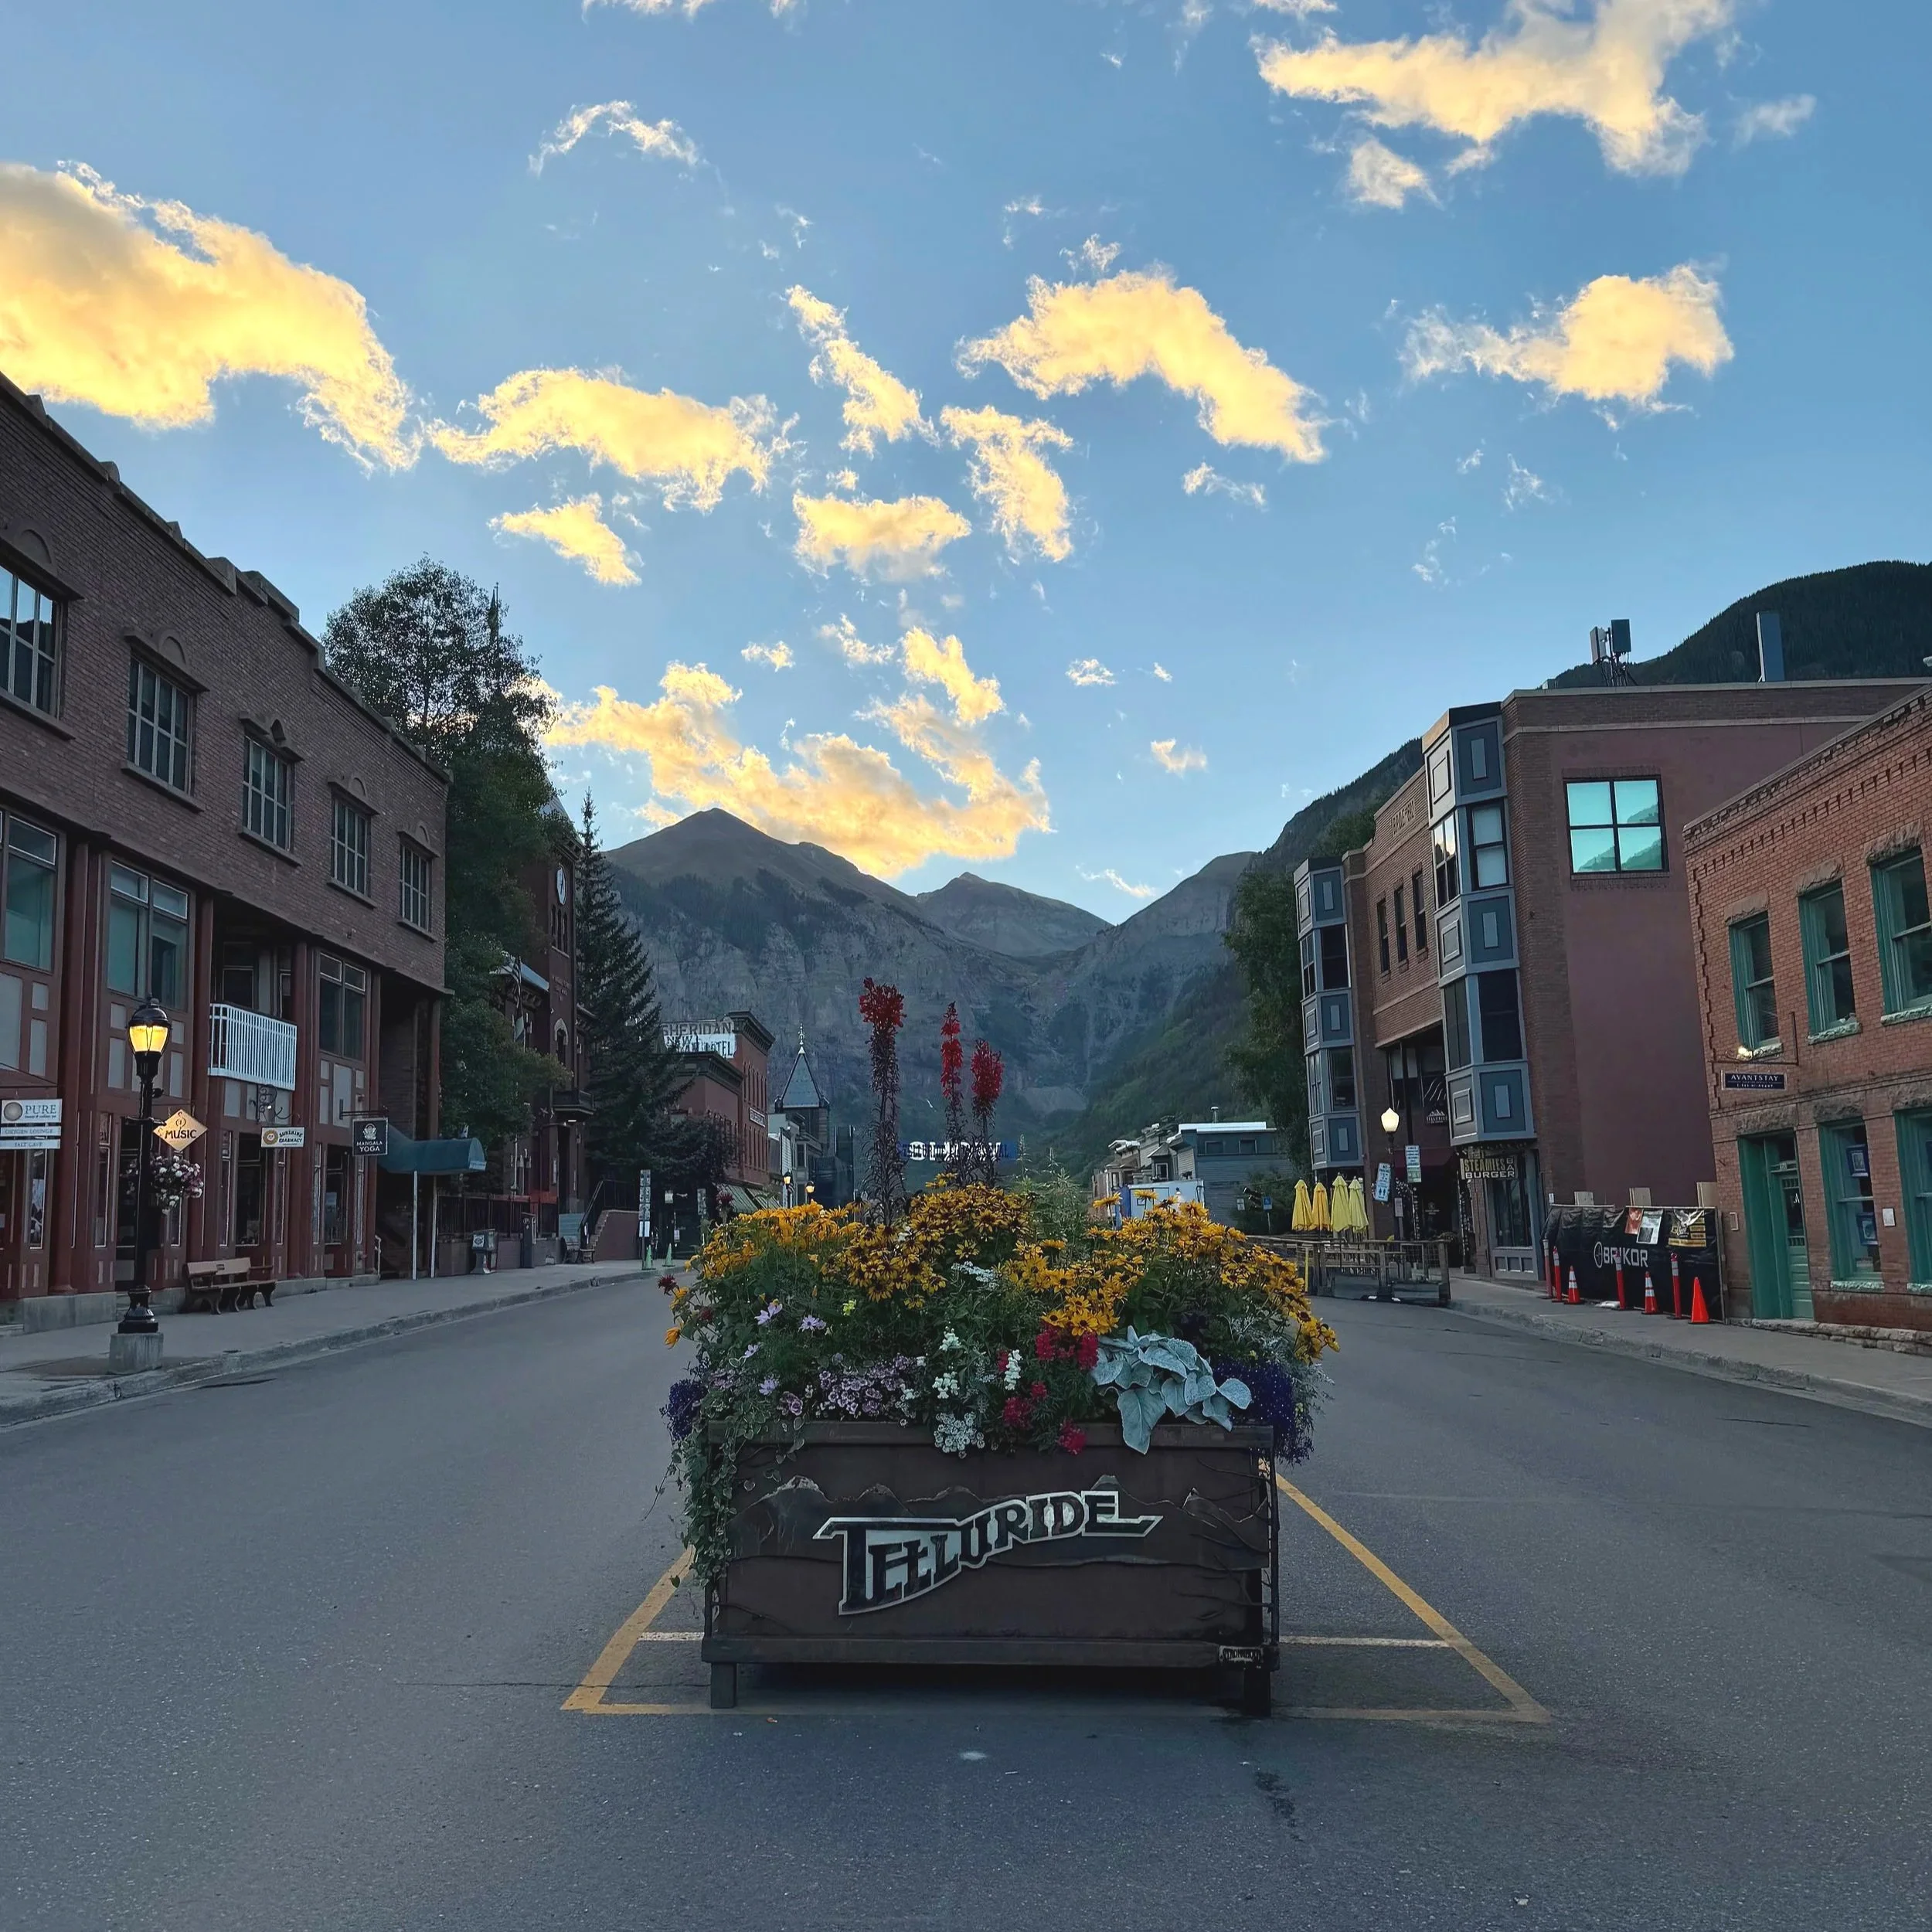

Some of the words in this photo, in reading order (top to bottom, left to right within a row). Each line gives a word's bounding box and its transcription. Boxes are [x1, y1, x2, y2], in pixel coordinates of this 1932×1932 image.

[662, 1021, 733, 1036] SHERIDAN
[25, 1104, 56, 1114] PURE
[165, 1129, 197, 1139] MUSIC
[1464, 1158, 1505, 1172] STEAMIES
[813, 1491, 1164, 1616] TELLURIDE
